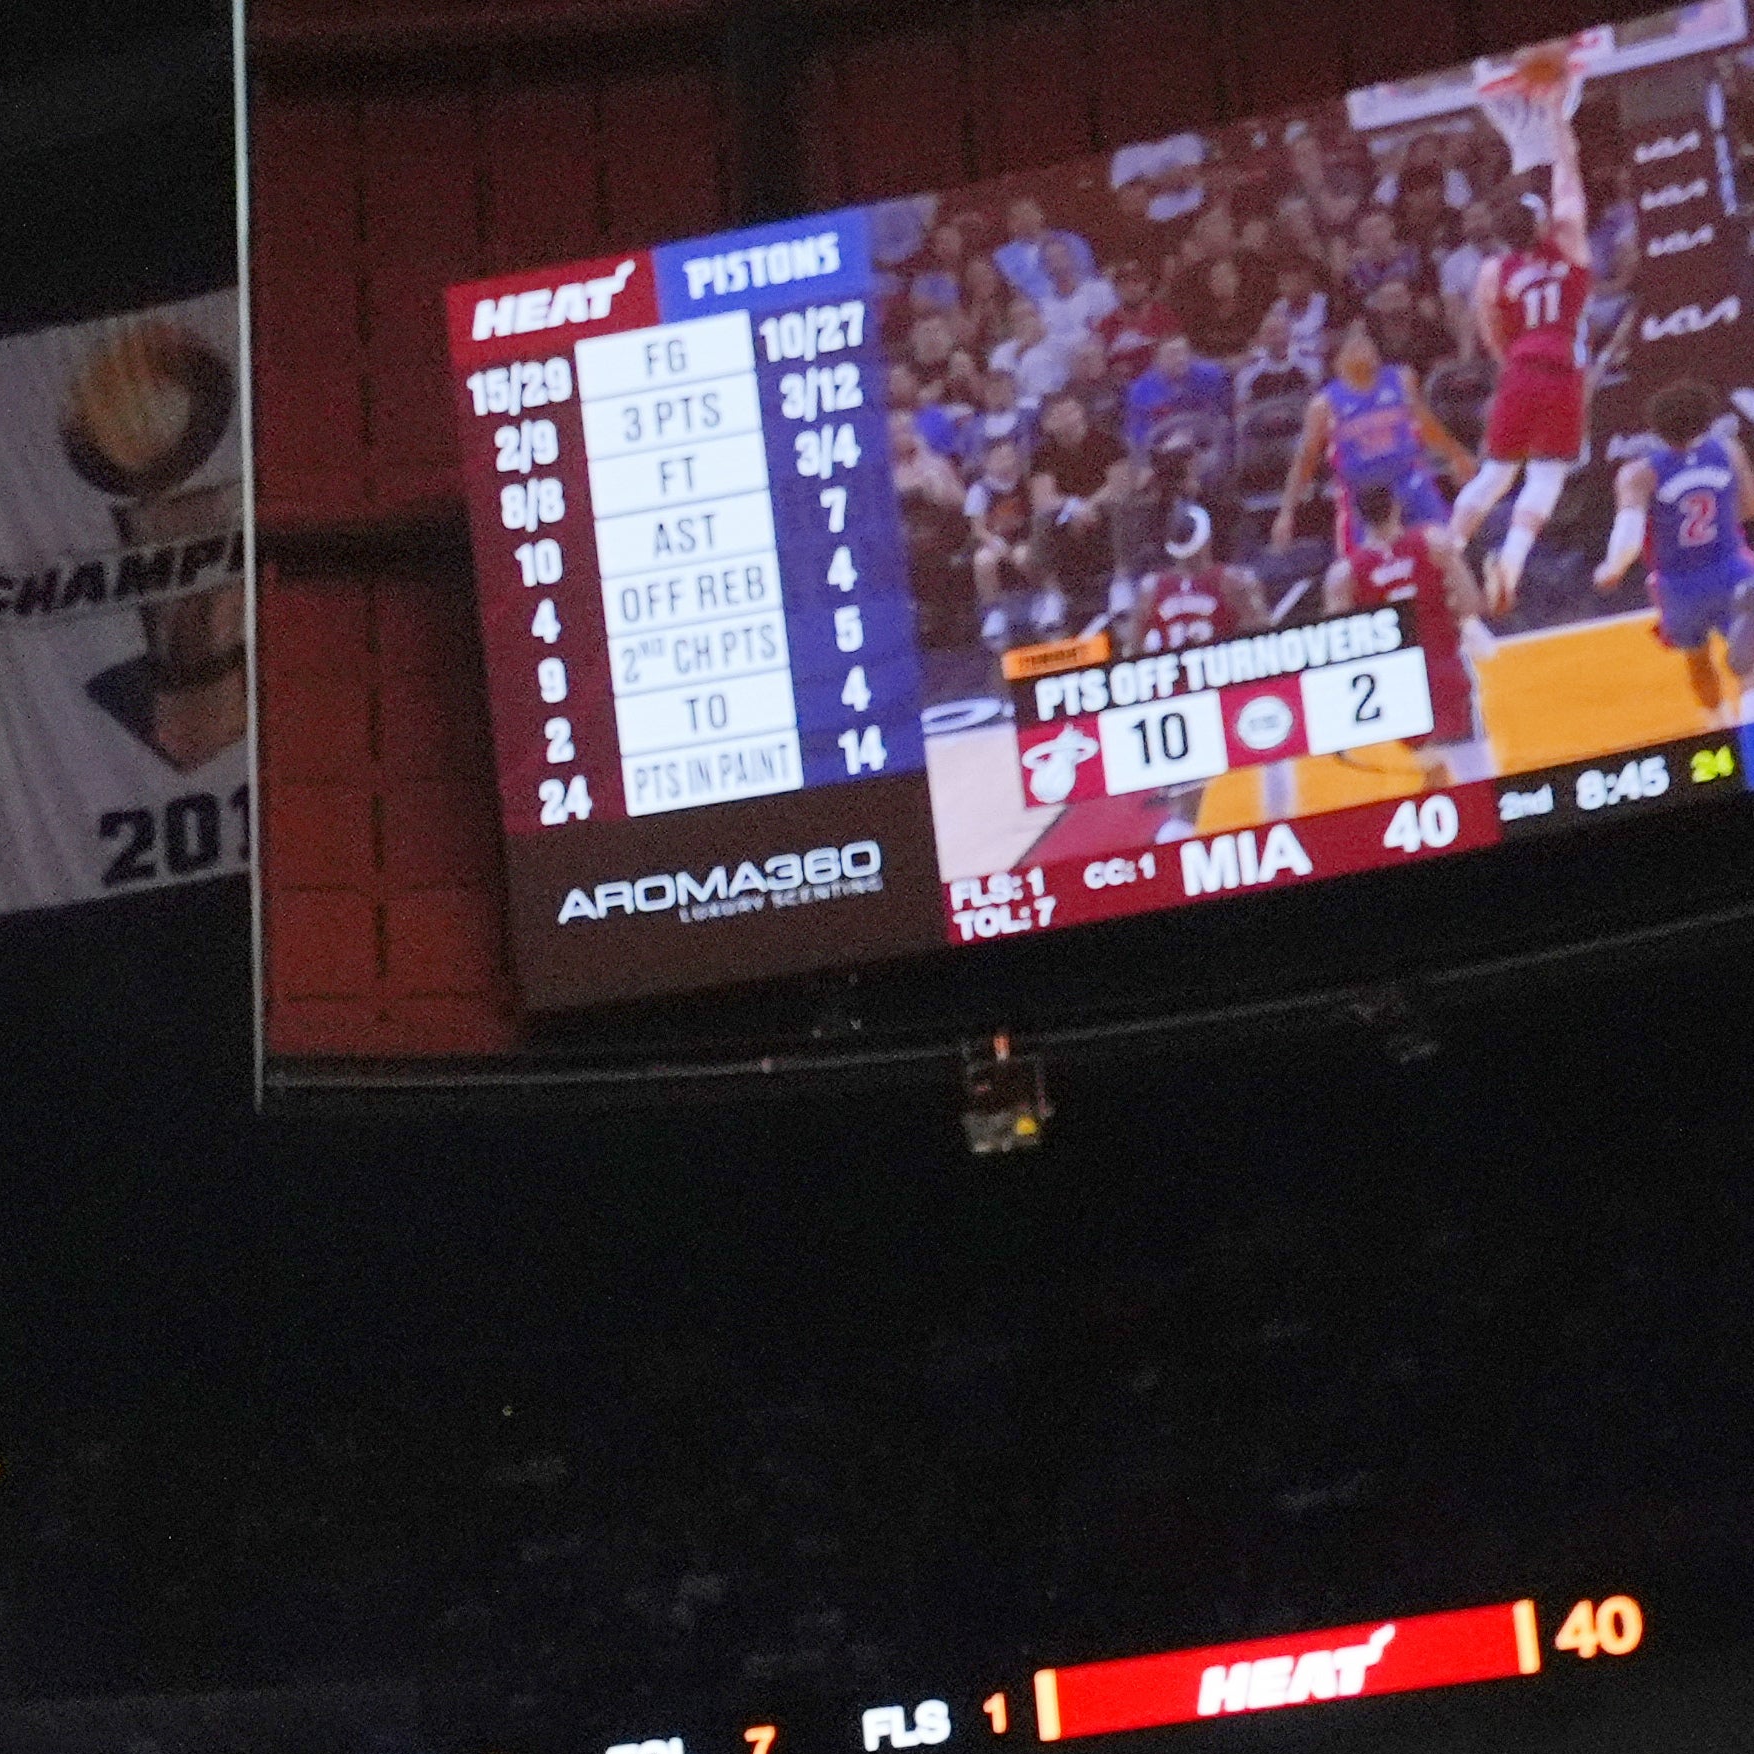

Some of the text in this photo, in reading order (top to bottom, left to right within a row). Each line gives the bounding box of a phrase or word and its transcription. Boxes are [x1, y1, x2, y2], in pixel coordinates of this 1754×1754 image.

[682, 231, 841, 300] PISTONS
[472, 259, 636, 341] HEAT
[759, 300, 865, 363] 10/27
[644, 340, 688, 377] FG
[466, 356, 573, 417] 15/29
[779, 361, 863, 422] 3/12
[623, 393, 722, 442] 3 PTS
[493, 419, 559, 473] 2/9
[794, 422, 862, 480] 3/4
[659, 456, 698, 495] FT
[653, 513, 717, 558] AST
[819, 486, 847, 534] 7
[1677, 486, 1717, 548] 2
[514, 538, 563, 588] 10
[827, 545, 858, 592] 4
[621, 565, 765, 623] OFF REB
[531, 597, 562, 644] 4
[833, 605, 864, 652] 5
[674, 624, 777, 676] CH PTS
[1034, 668, 1109, 722] PTS
[1109, 655, 1181, 710] OFF
[1181, 607, 1403, 692] TURNOVERS
[537, 657, 568, 704] 9
[841, 665, 872, 712] 4
[1350, 673, 1382, 725] 2
[686, 694, 728, 732] TO
[544, 716, 576, 764] 2
[838, 724, 887, 775] 14
[1133, 713, 1190, 766] 10
[635, 764, 681, 802] PTS
[719, 744, 789, 786] PAINT
[539, 775, 593, 827] 24
[1180, 822, 1313, 897] MIA
[1384, 794, 1460, 854] 40
[1576, 755, 1670, 811] 8:45
[1690, 745, 1736, 783] 24
[557, 839, 882, 925] AROMA360
[1196, 1593, 1645, 1718] HEAT 40
[862, 1699, 952, 1752] FLS
[983, 1691, 1008, 1734] 1
